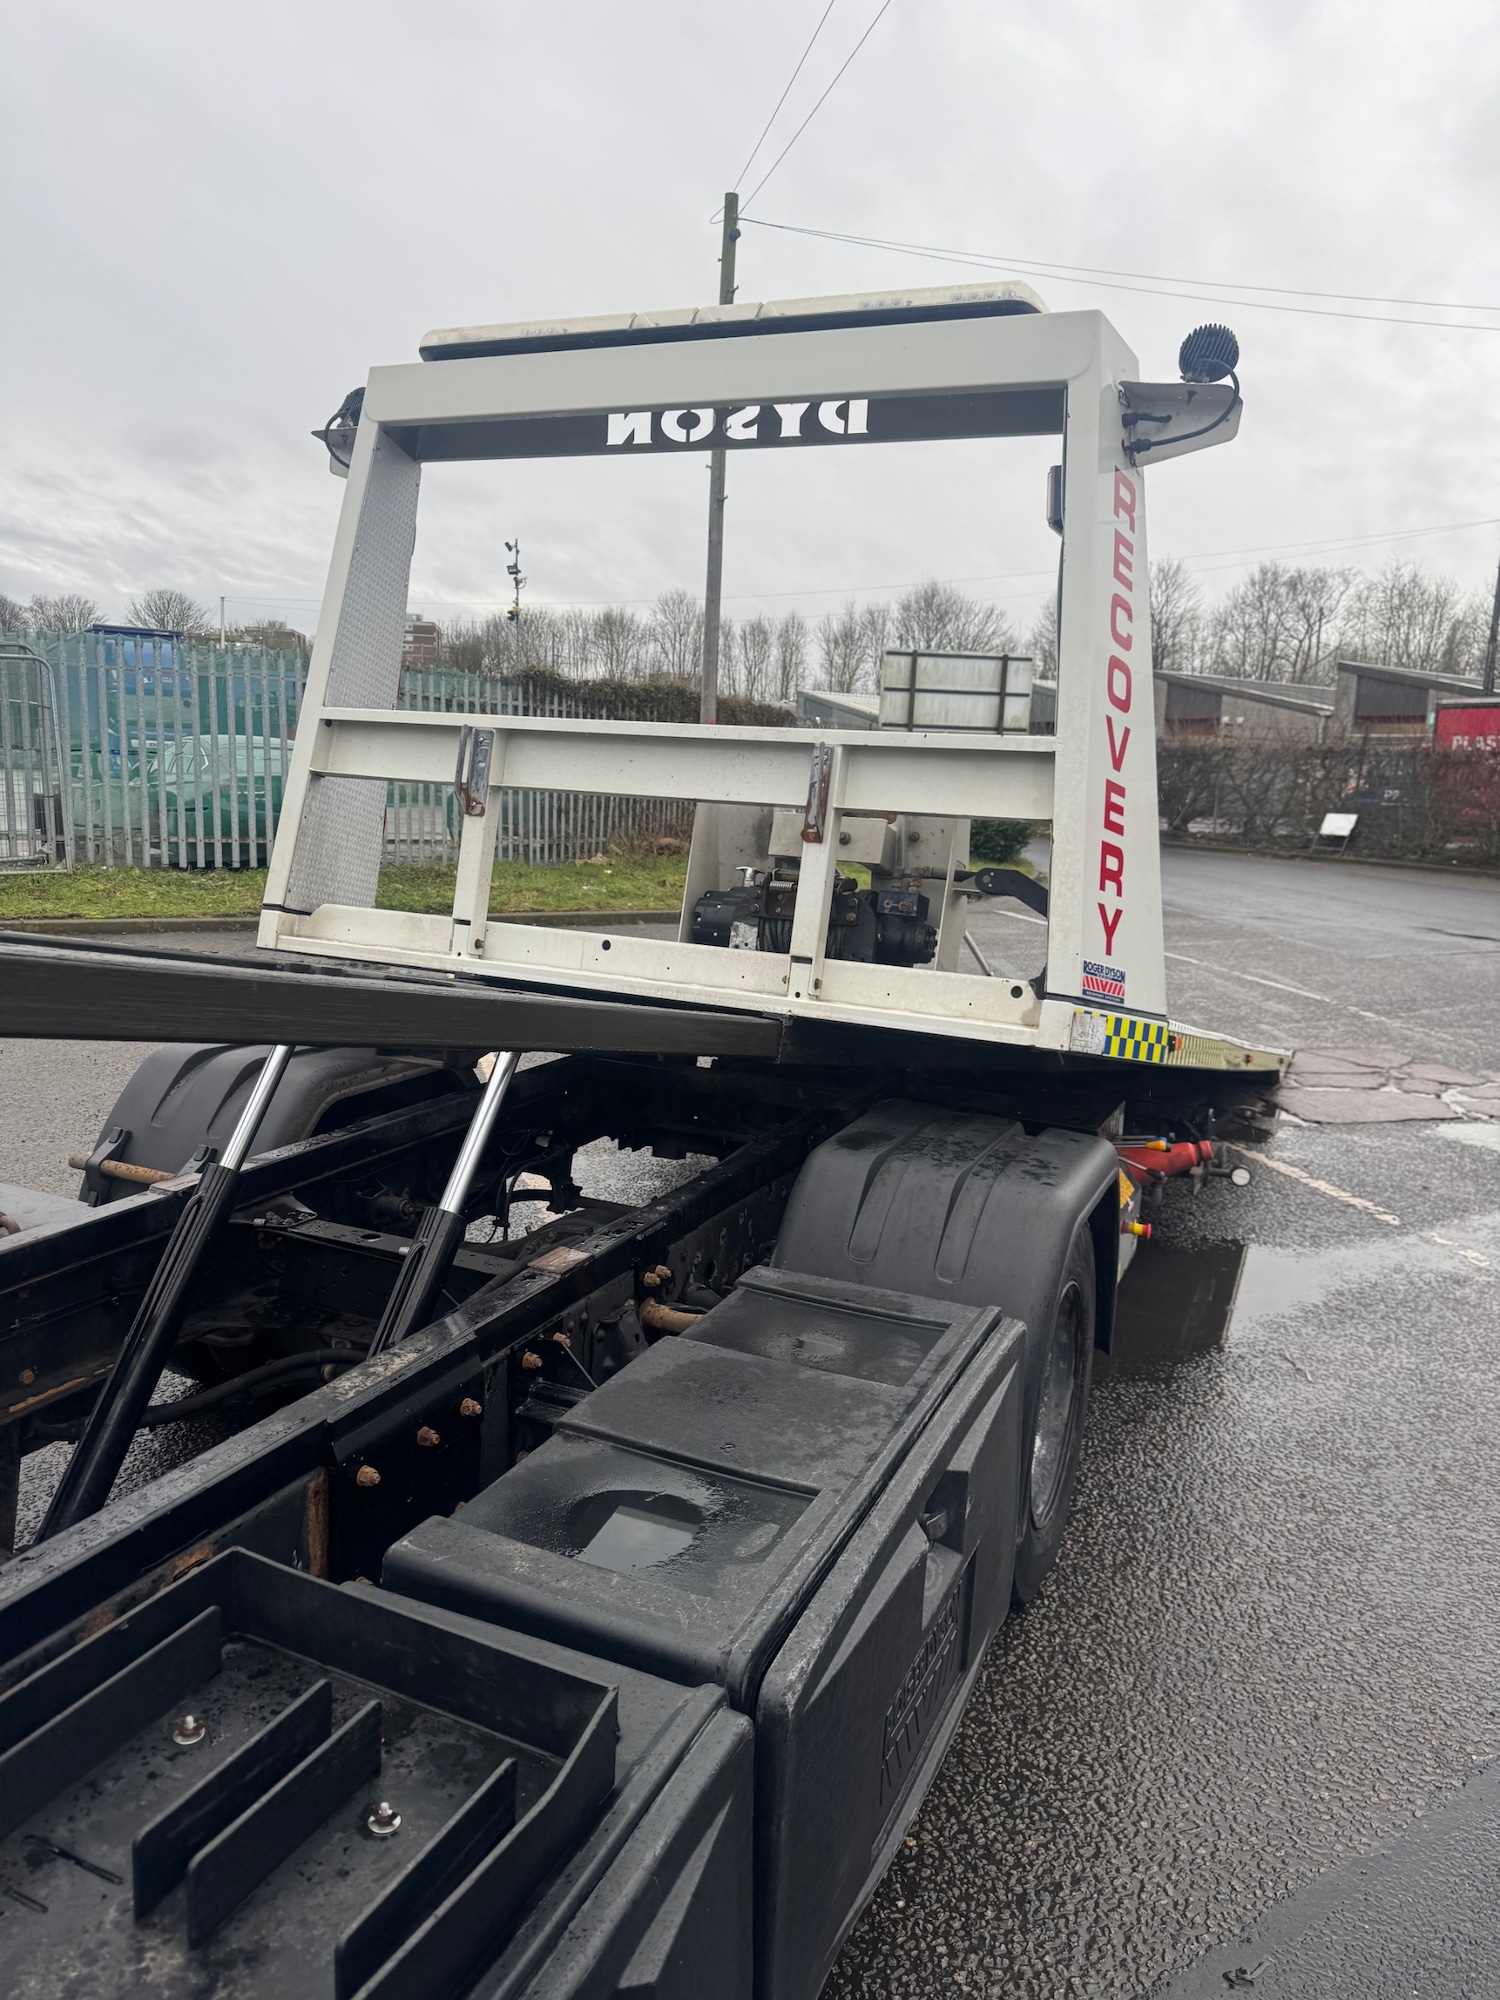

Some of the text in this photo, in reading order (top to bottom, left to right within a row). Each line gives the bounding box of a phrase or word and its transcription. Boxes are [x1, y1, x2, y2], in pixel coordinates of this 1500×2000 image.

[1097, 465, 1137, 957] RECOVERY
[1083, 960, 1105, 976] ROGER
[1105, 966, 1126, 984] DYSON
